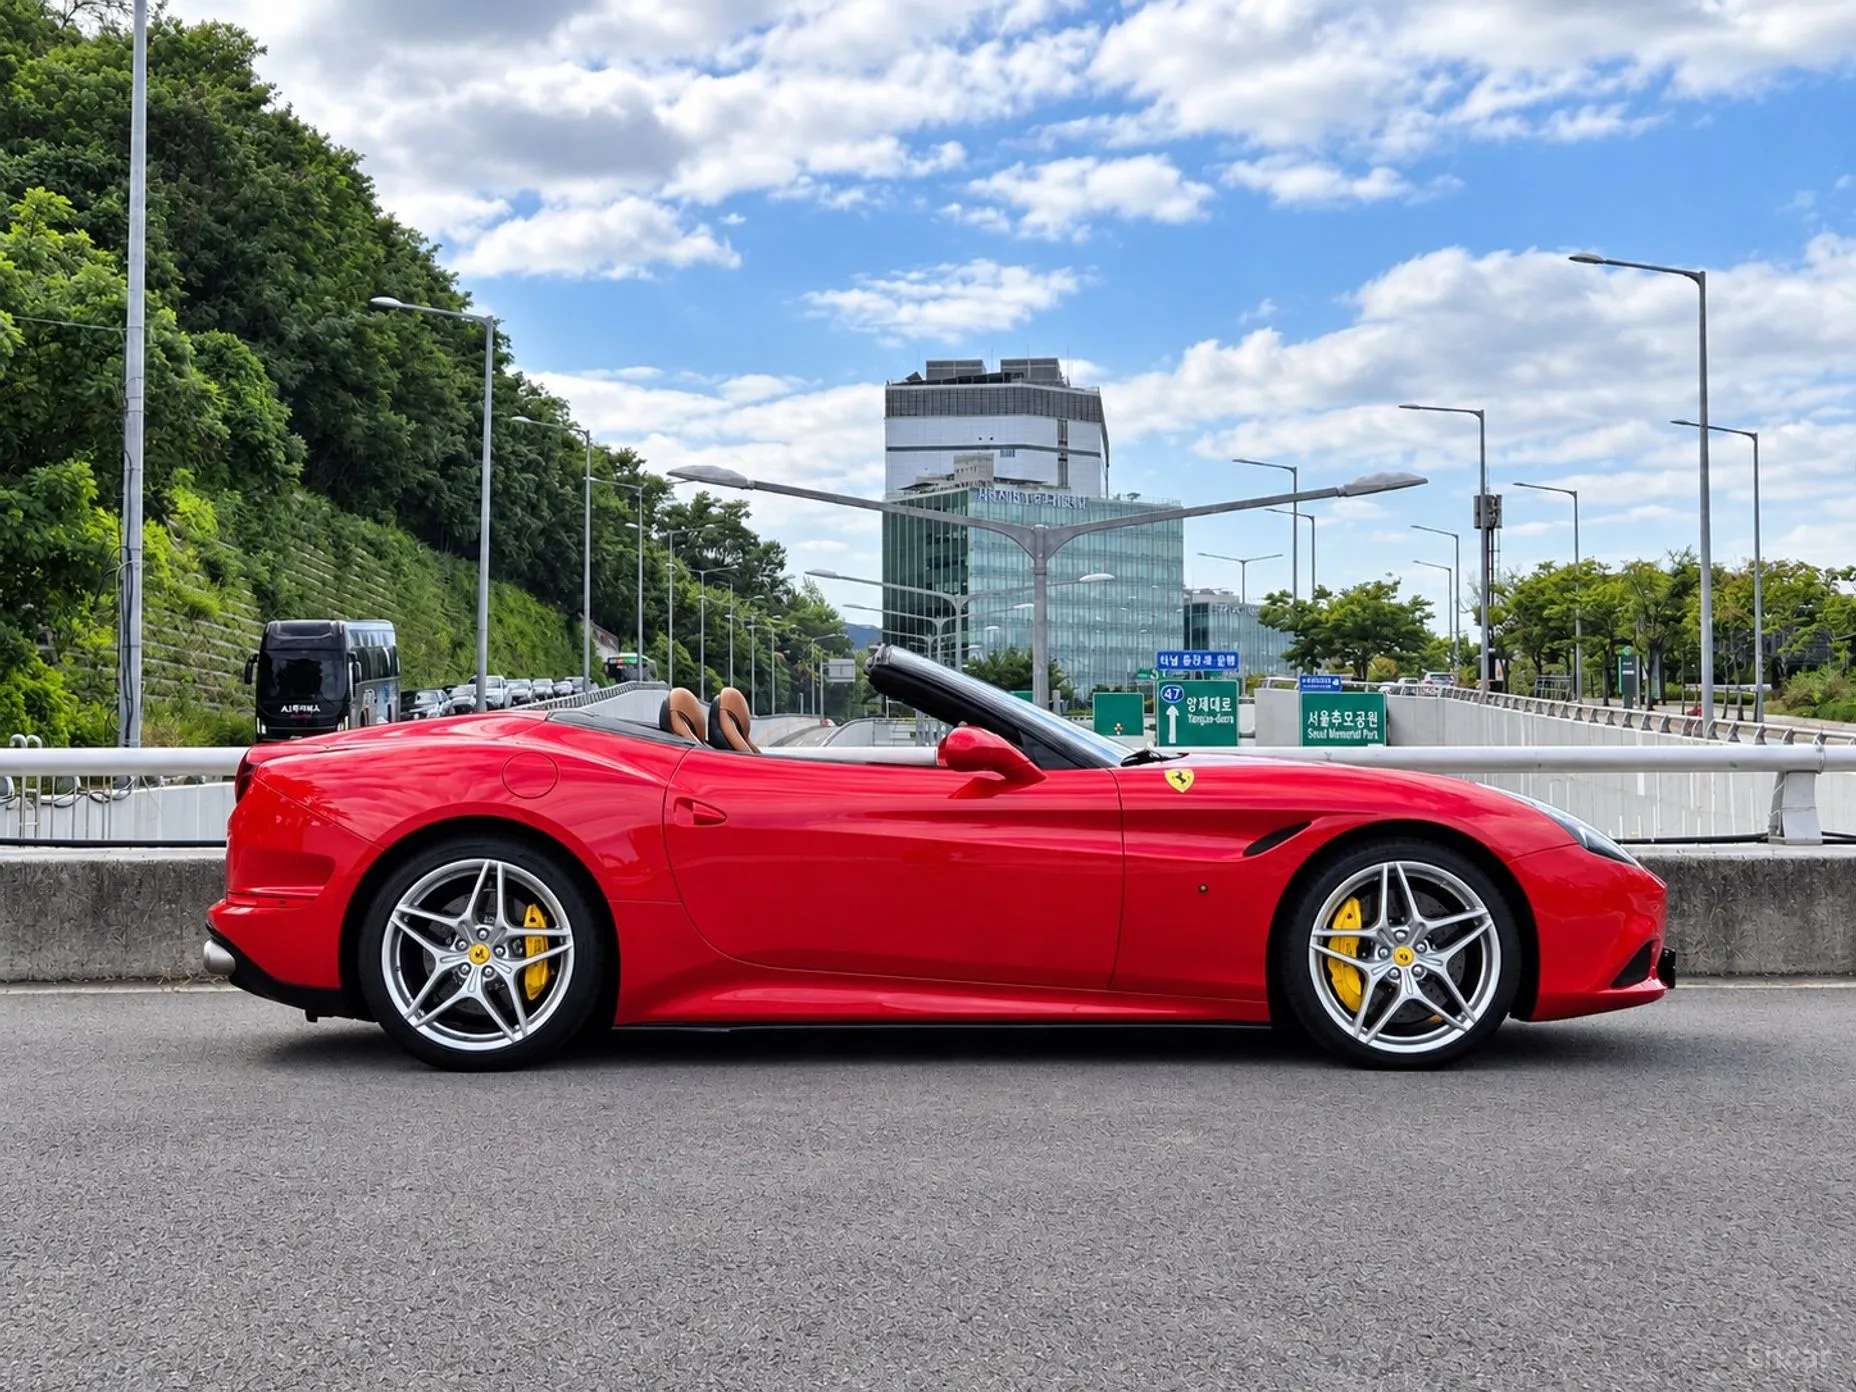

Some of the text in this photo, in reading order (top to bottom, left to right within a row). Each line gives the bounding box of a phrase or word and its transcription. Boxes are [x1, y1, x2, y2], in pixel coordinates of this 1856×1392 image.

[1164, 688, 1180, 700] 47
[1307, 709, 1378, 728] 서울추모공원
[1307, 728, 1379, 740] Seoul Memorial Park
